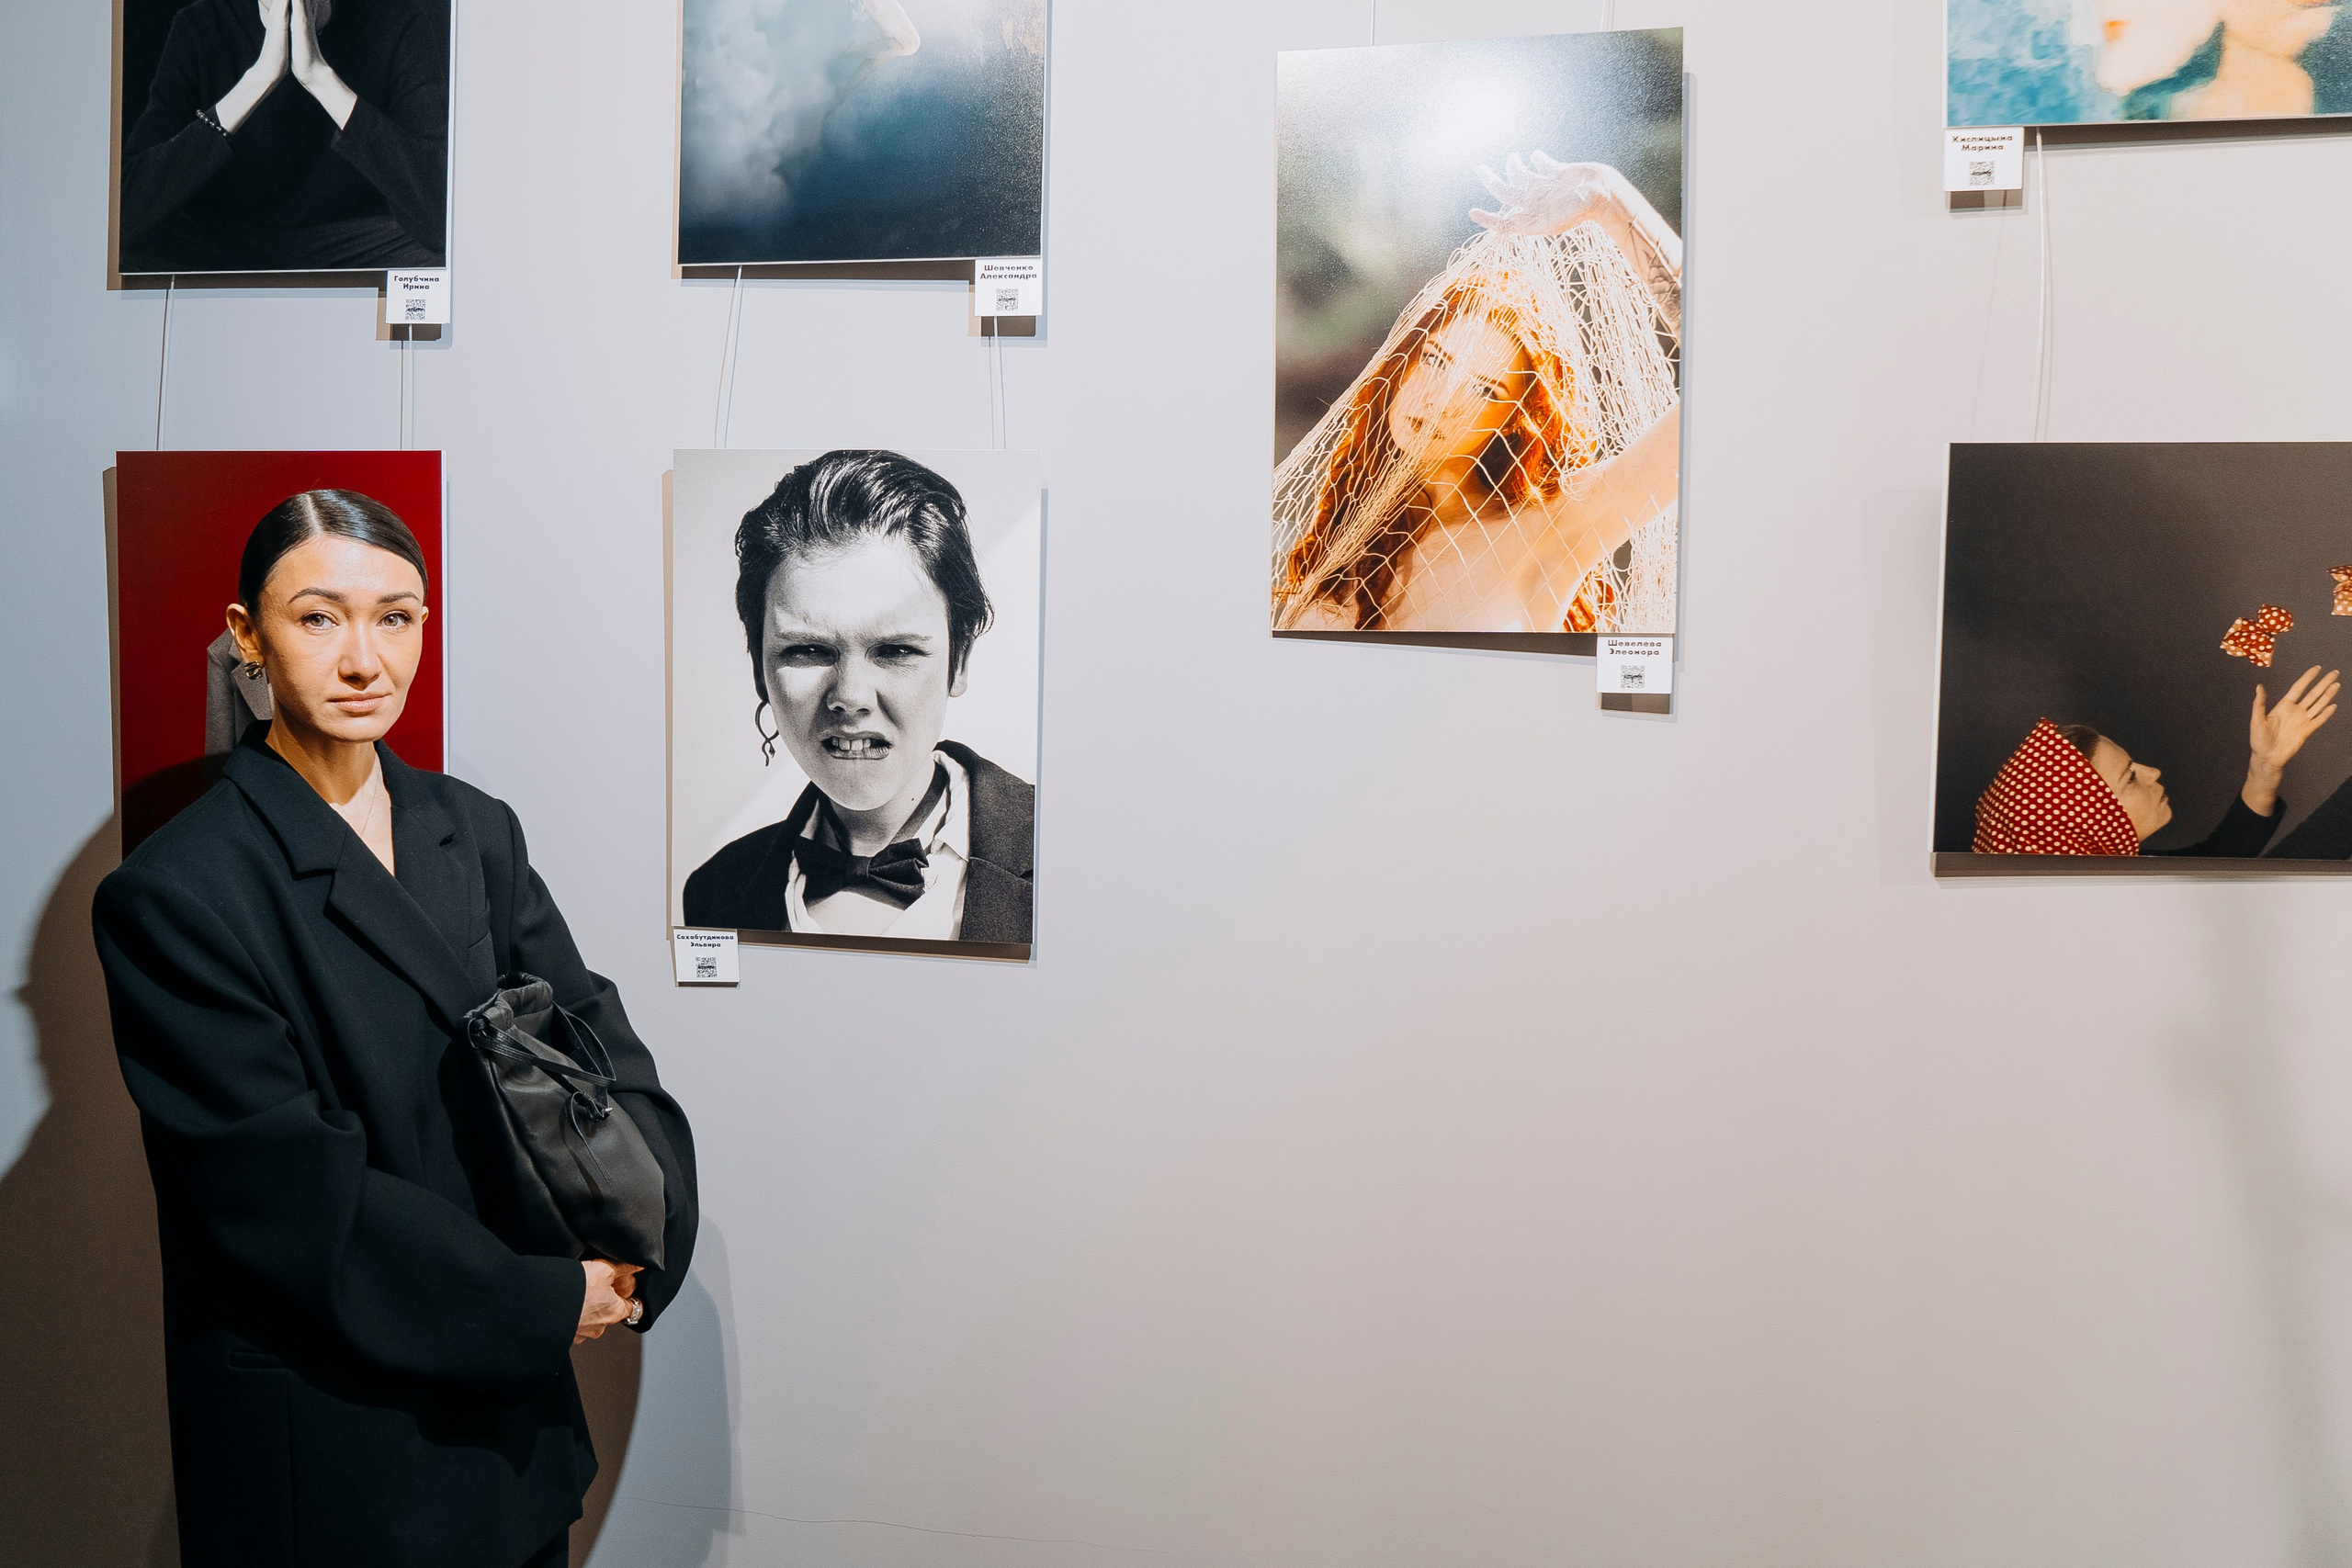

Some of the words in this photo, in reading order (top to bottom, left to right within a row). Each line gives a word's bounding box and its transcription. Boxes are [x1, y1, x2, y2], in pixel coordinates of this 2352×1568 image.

[1952, 135, 2013, 143] Кислицына
[1962, 144, 2004, 152] Марина
[393, 275, 440, 283] Голубчина
[402, 283, 430, 291] Ирина
[1609, 648, 1659, 657] Элеонора
